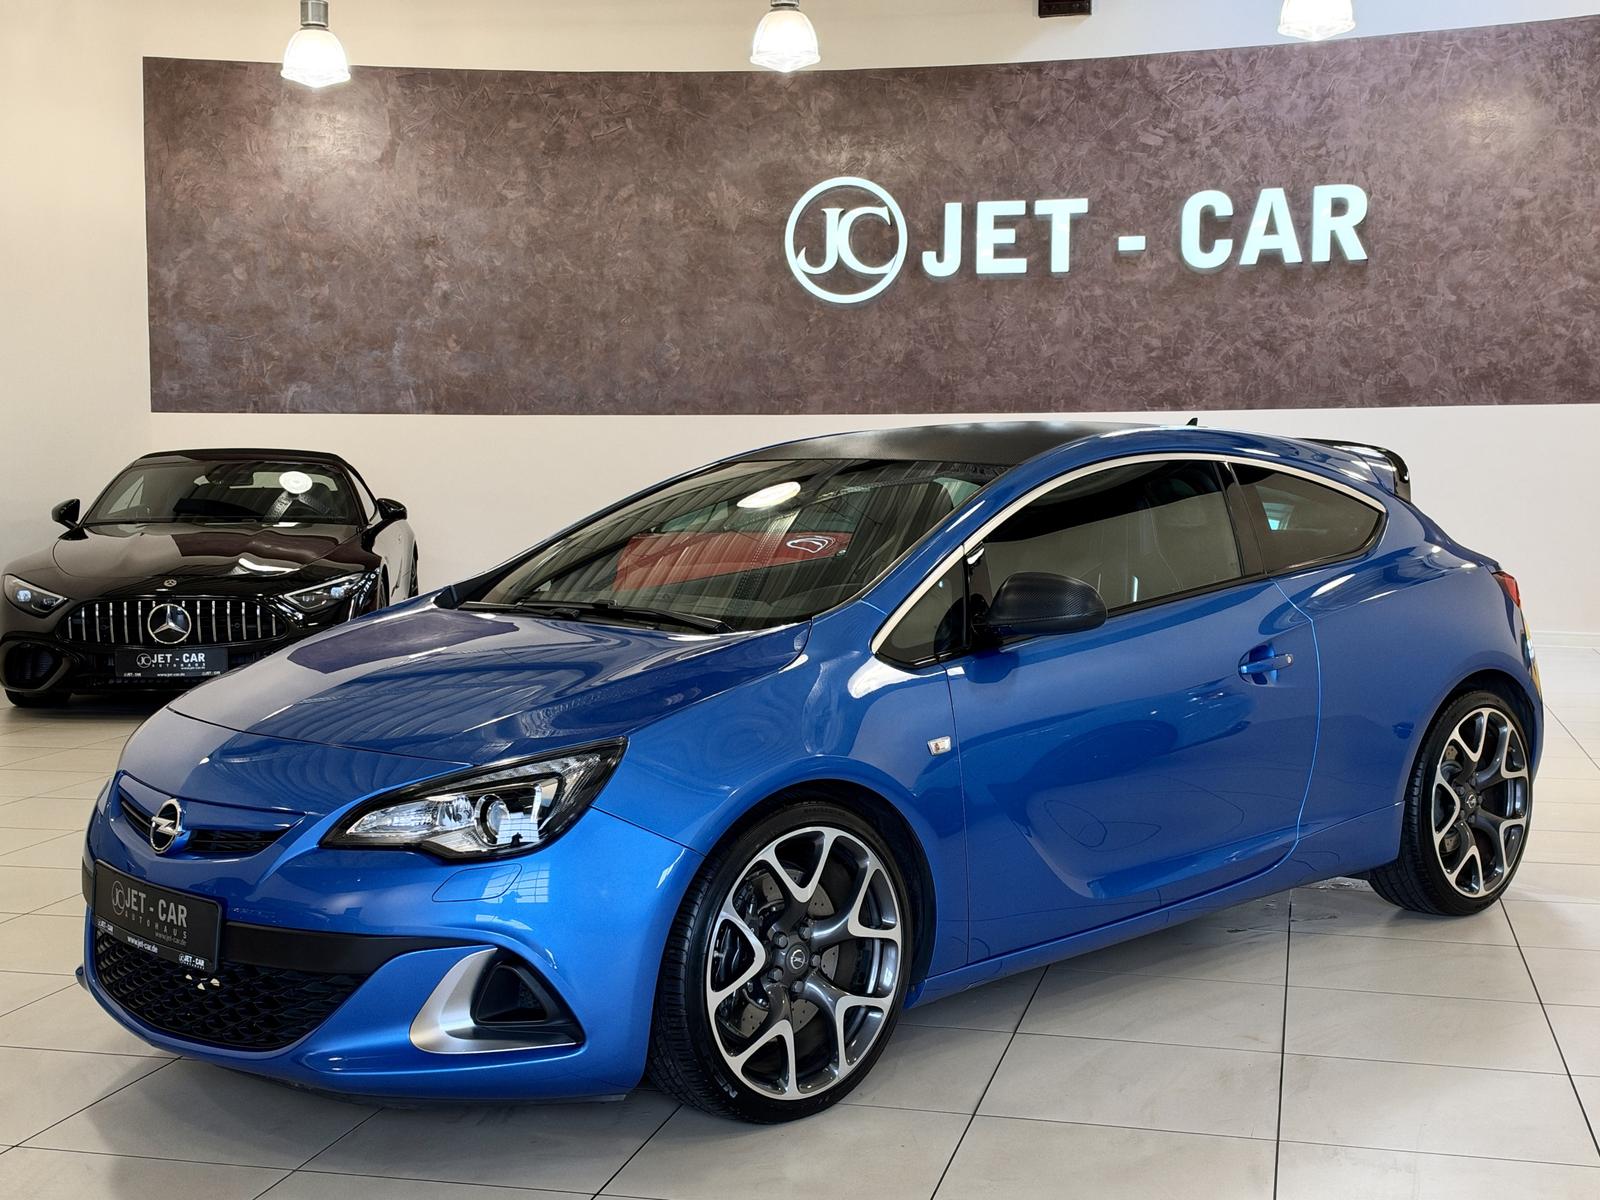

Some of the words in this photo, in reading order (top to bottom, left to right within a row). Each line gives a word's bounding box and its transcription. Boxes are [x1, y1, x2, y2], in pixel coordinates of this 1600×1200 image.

[922, 198, 1089, 277] JET
[1180, 184, 1368, 270] CAR
[151, 653, 173, 663] JET
[182, 653, 205, 663] CAR
[125, 887, 146, 914] JET
[158, 899, 188, 928] CAR
